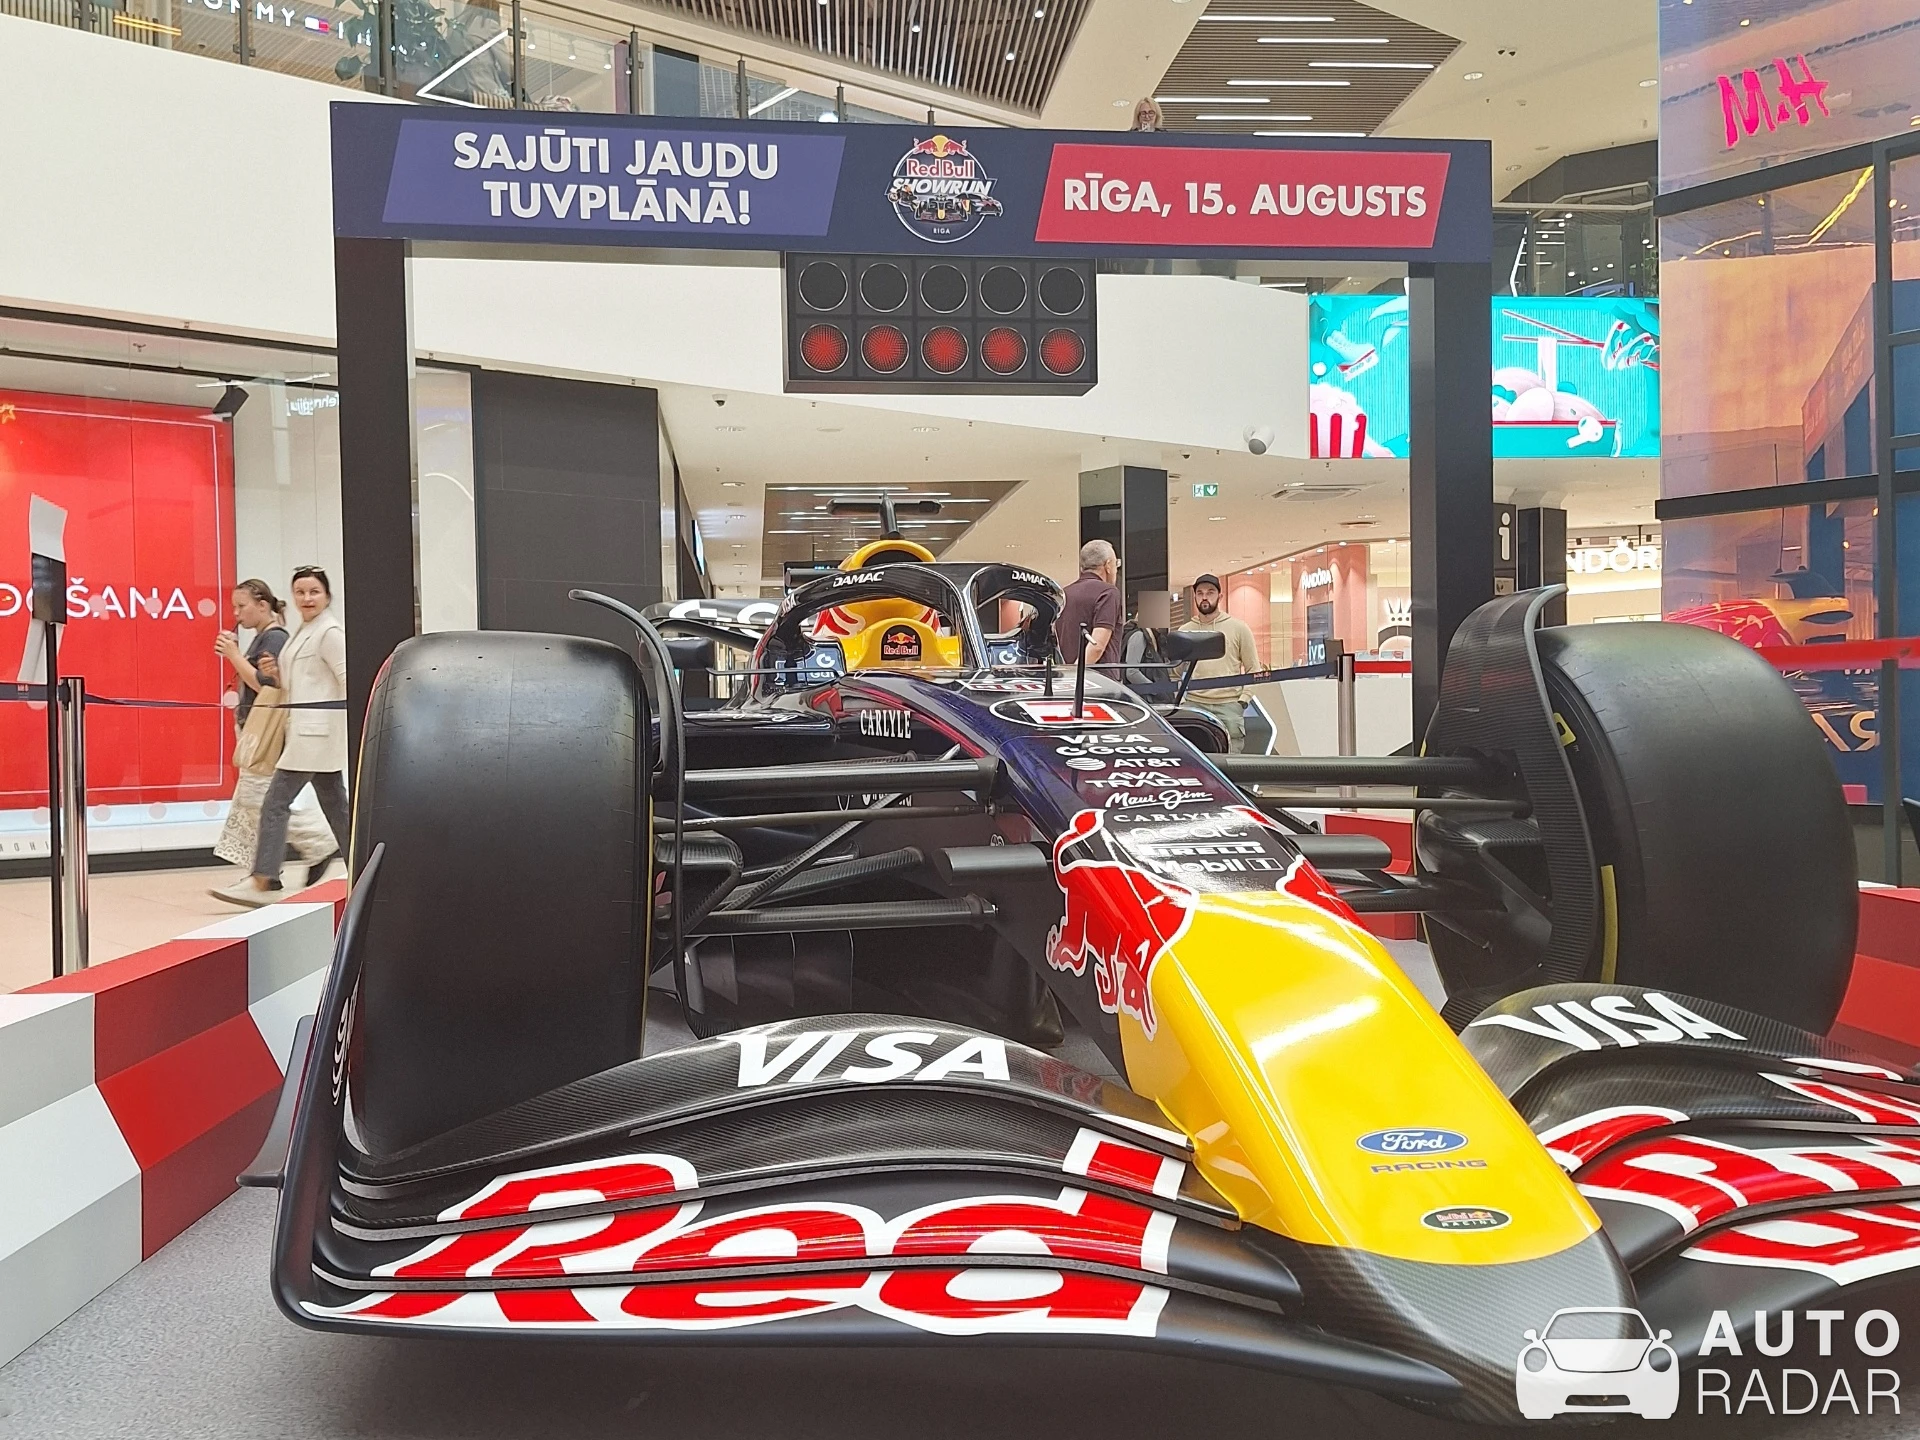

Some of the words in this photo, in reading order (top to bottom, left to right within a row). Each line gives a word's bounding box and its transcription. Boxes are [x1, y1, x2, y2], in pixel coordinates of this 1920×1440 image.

[453, 128, 610, 173] SAJŪTI
[625, 140, 778, 180] JAUDU
[906, 158, 941, 177] Red
[942, 159, 975, 178] Bull
[892, 178, 993, 196] SHOWRUN
[1063, 172, 1172, 218] RĪGA,
[1184, 182, 1237, 215] 15.
[1249, 184, 1428, 218] AUGUSTS
[482, 179, 751, 226] TUVPLĀNĀ!
[832, 571, 885, 588] DAMAC
[1011, 570, 1046, 587] DAMAC
[883, 644, 900, 656] Red
[900, 644, 919, 656] Bull
[860, 709, 912, 739] CARLYLE
[1058, 734, 1153, 744] VISA
[1094, 746, 1170, 755] Gate
[1114, 757, 1182, 768] AT&T
[1085, 779, 1203, 788] TRADE
[1105, 792, 1157, 808] Maui
[1157, 789, 1214, 810] Jim
[1151, 858, 1247, 873] Mobil
[1469, 992, 1748, 1051] VISA
[717, 1031, 1010, 1087] VISA
[1381, 1131, 1448, 1151] Ford
[1371, 1159, 1488, 1174] RACING
[300, 1114, 1190, 1338] Red
